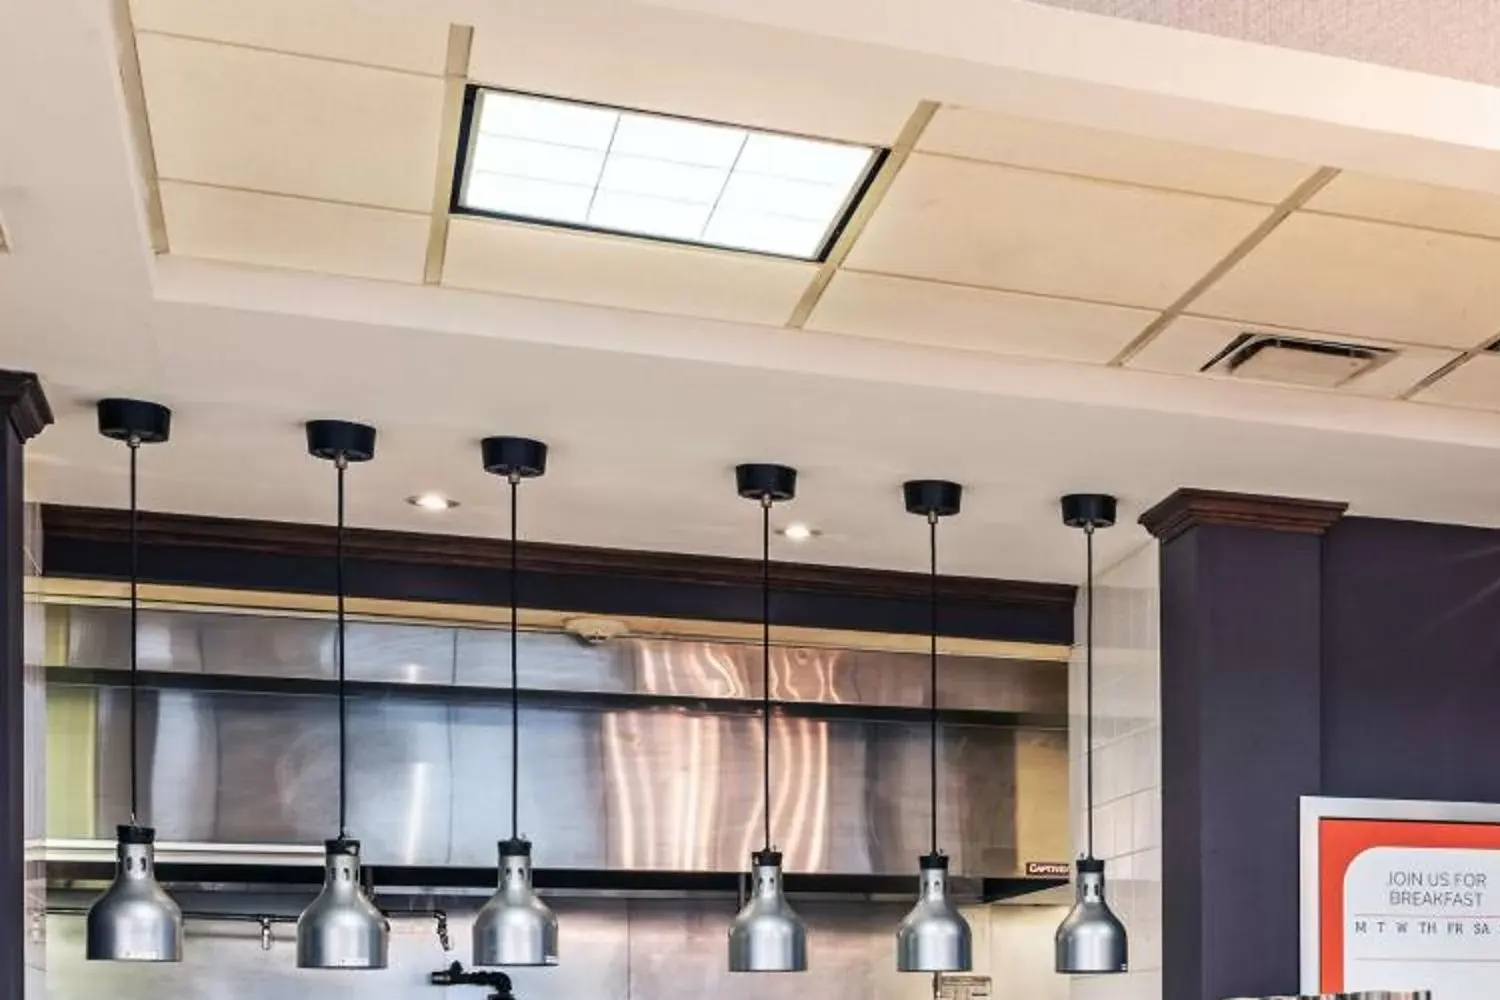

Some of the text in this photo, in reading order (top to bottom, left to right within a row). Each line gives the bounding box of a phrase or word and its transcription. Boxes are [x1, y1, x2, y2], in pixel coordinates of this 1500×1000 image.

[1386, 871, 1487, 889] JOIN US FOR
[1389, 890, 1484, 907] BREAKFAST
[1355, 921, 1367, 933] M
[1377, 921, 1385, 933] T
[1396, 921, 1408, 933] W
[1418, 921, 1437, 934] TH
[1447, 922, 1463, 934] FR
[1473, 923, 1491, 935] SA
